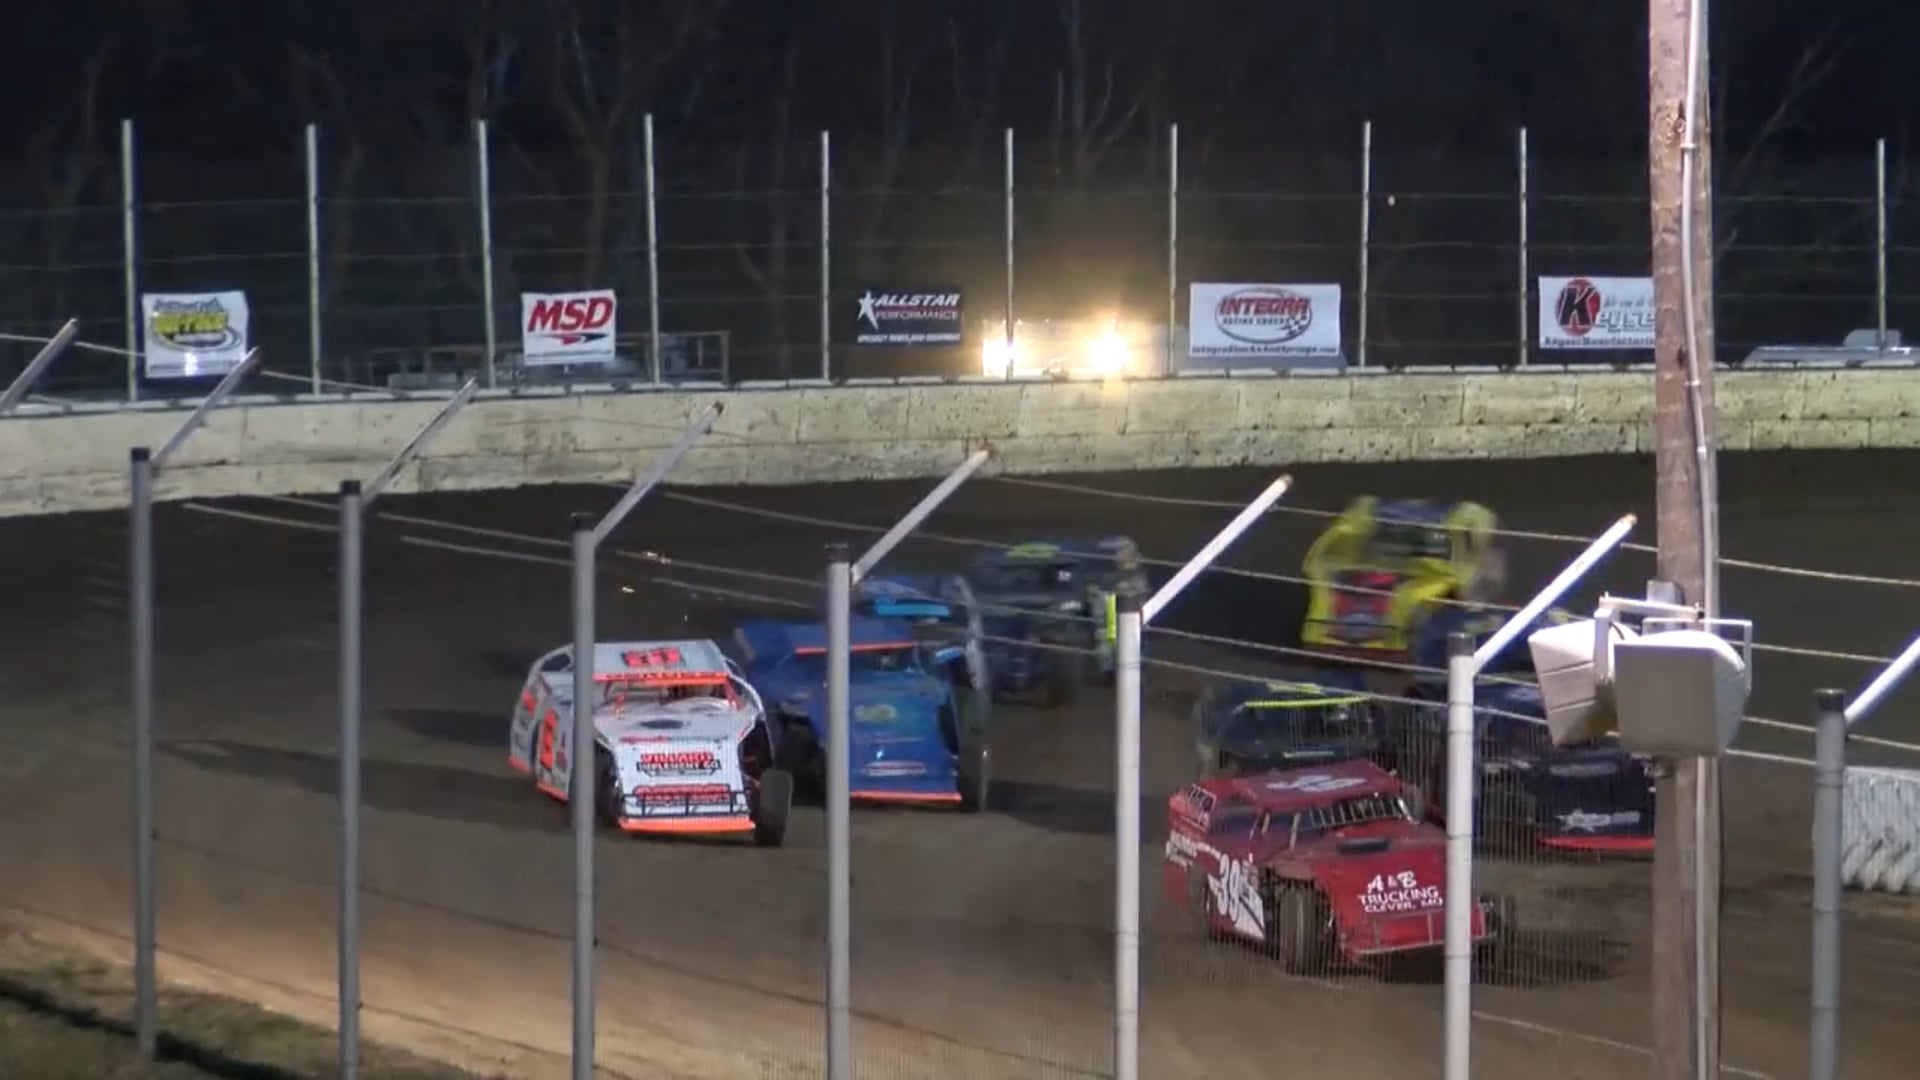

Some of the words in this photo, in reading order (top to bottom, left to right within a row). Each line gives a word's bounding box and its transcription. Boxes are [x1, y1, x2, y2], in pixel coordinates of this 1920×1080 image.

[874, 293, 961, 307] ALLSTAR
[1219, 297, 1311, 316] INTEGRA
[527, 297, 613, 332] MSD
[875, 311, 958, 320] PERFORMANCE
[1367, 874, 1384, 894] A
[1397, 869, 1417, 888] B
[1357, 885, 1439, 905] TRUCKING
